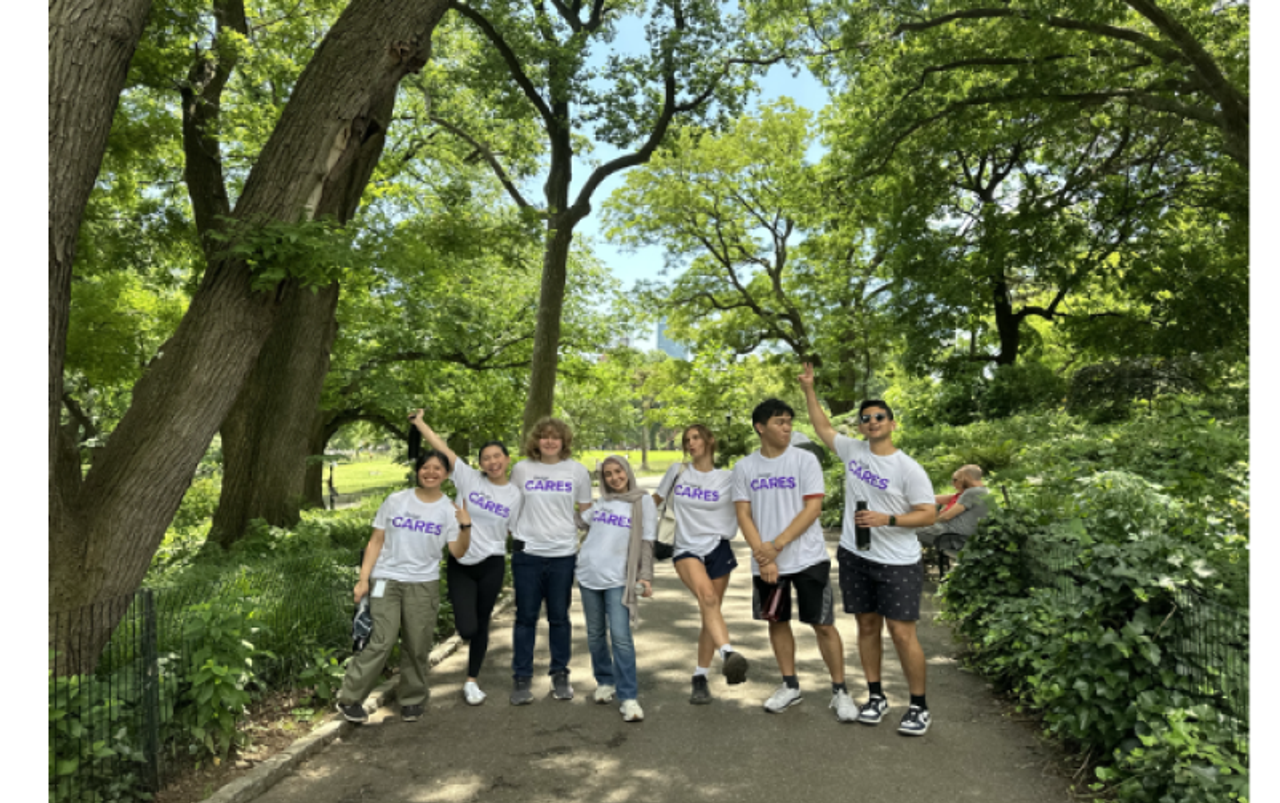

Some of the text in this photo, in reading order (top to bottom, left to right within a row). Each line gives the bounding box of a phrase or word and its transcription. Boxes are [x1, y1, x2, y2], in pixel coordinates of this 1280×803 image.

[751, 476, 797, 491] CARES
[848, 460, 890, 490] CARES
[524, 479, 573, 493] CARES
[674, 484, 720, 502] CARES
[469, 492, 510, 518] CARES
[392, 516, 442, 536] CARES
